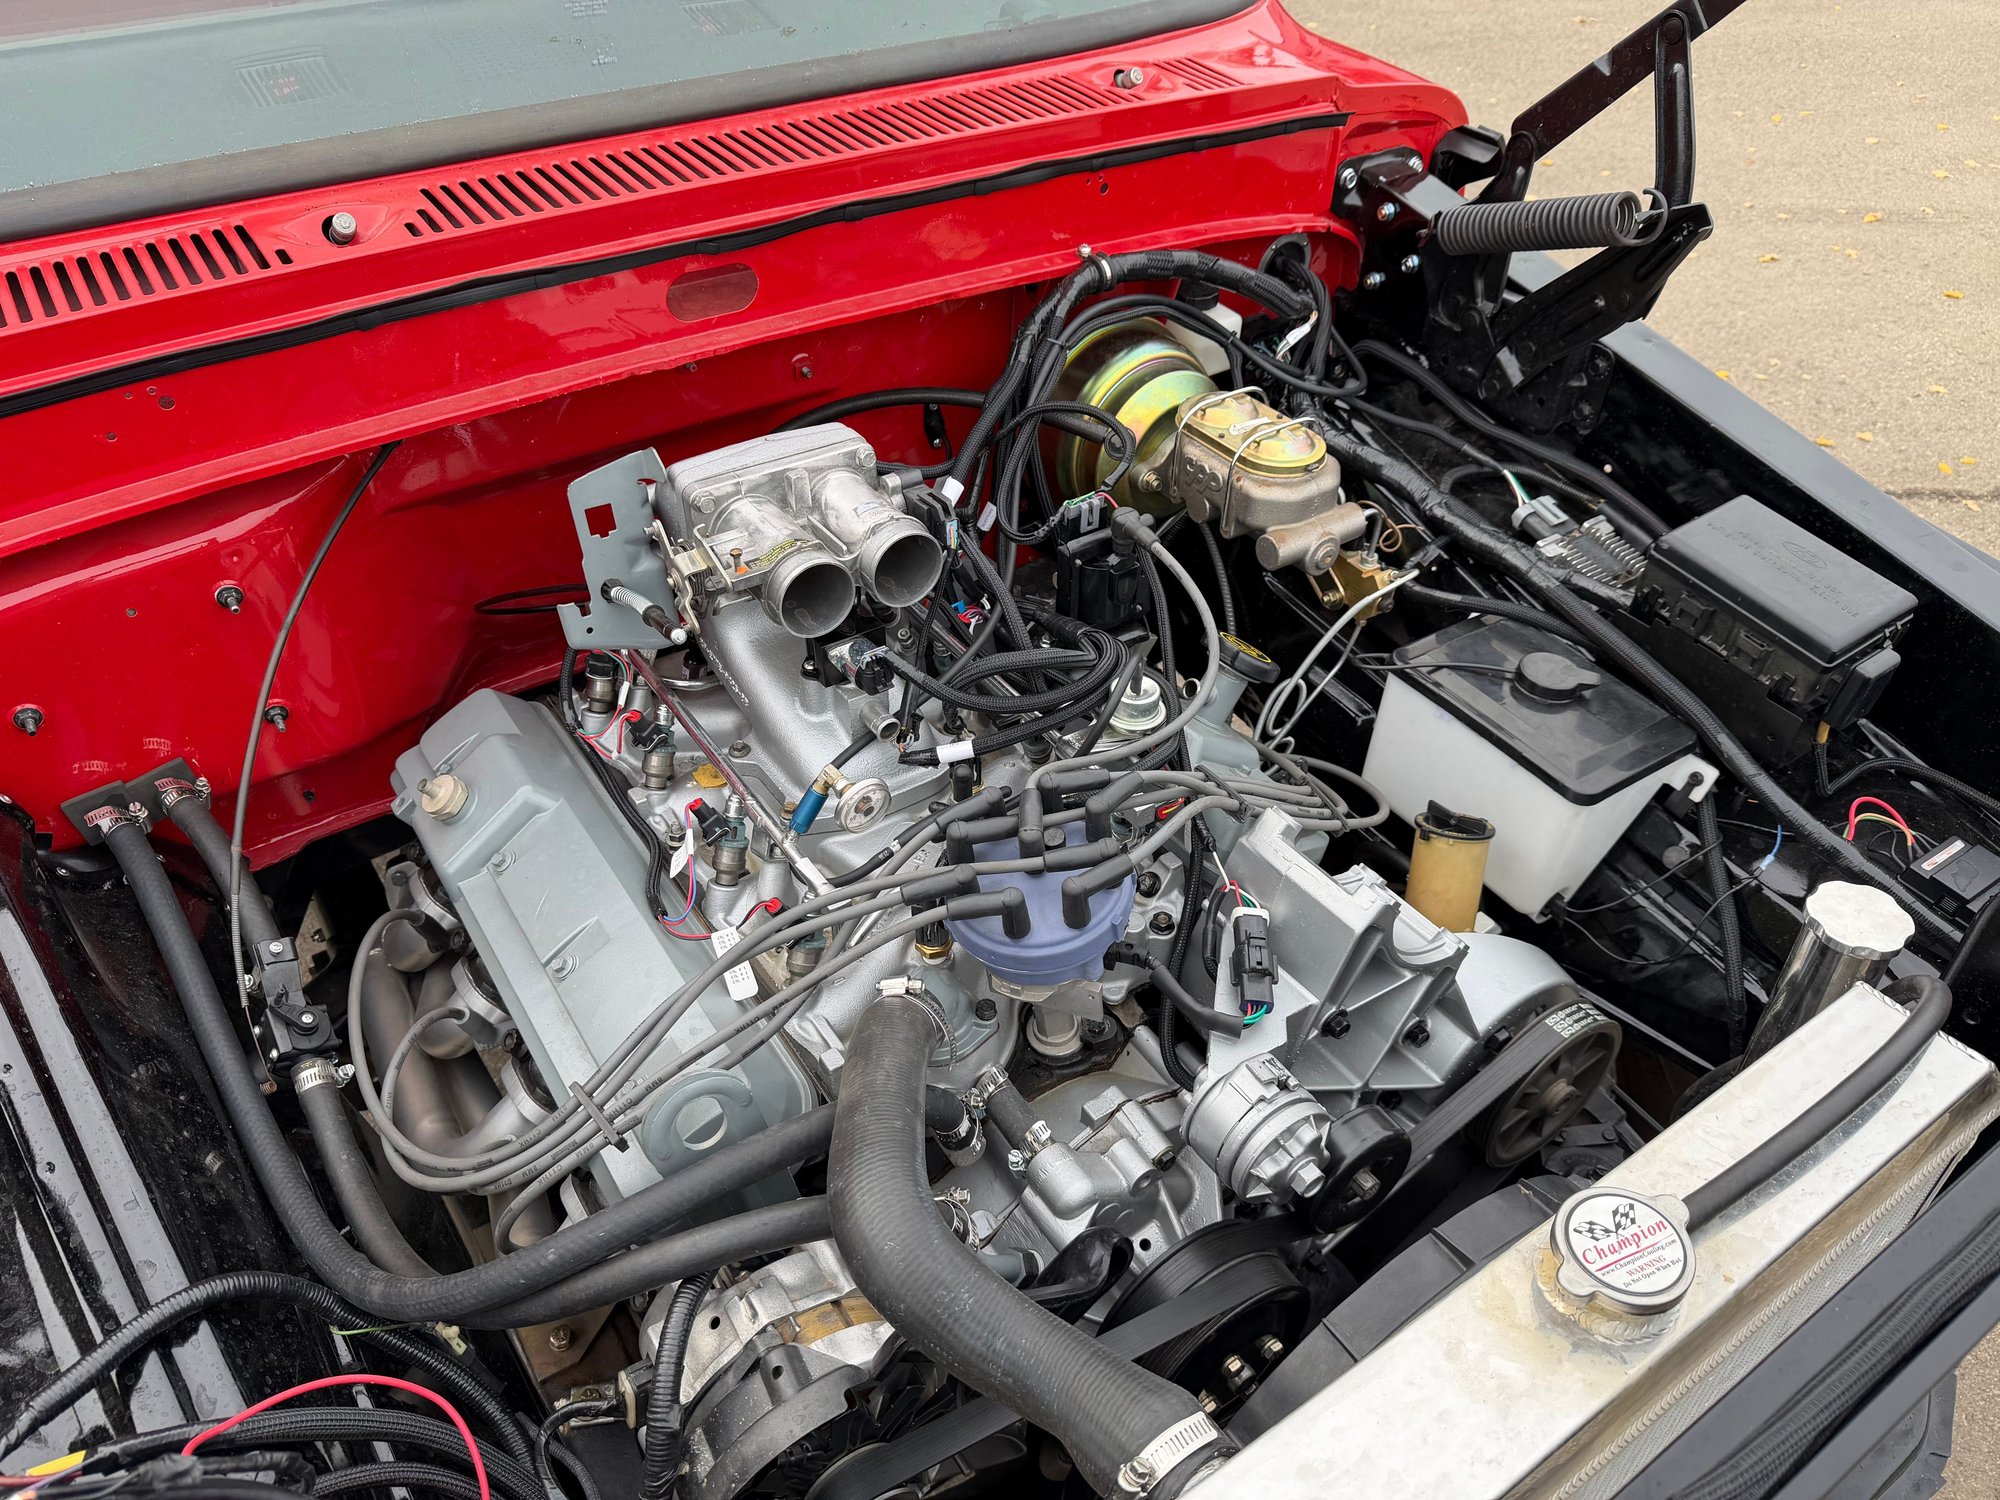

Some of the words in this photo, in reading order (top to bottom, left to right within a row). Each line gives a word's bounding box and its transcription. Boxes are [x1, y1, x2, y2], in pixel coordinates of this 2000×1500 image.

[1582, 1219, 1668, 1265] Champion
[1600, 1238, 1678, 1278] www.ChampionCooling.com
[1625, 1254, 1667, 1278] WARNING
